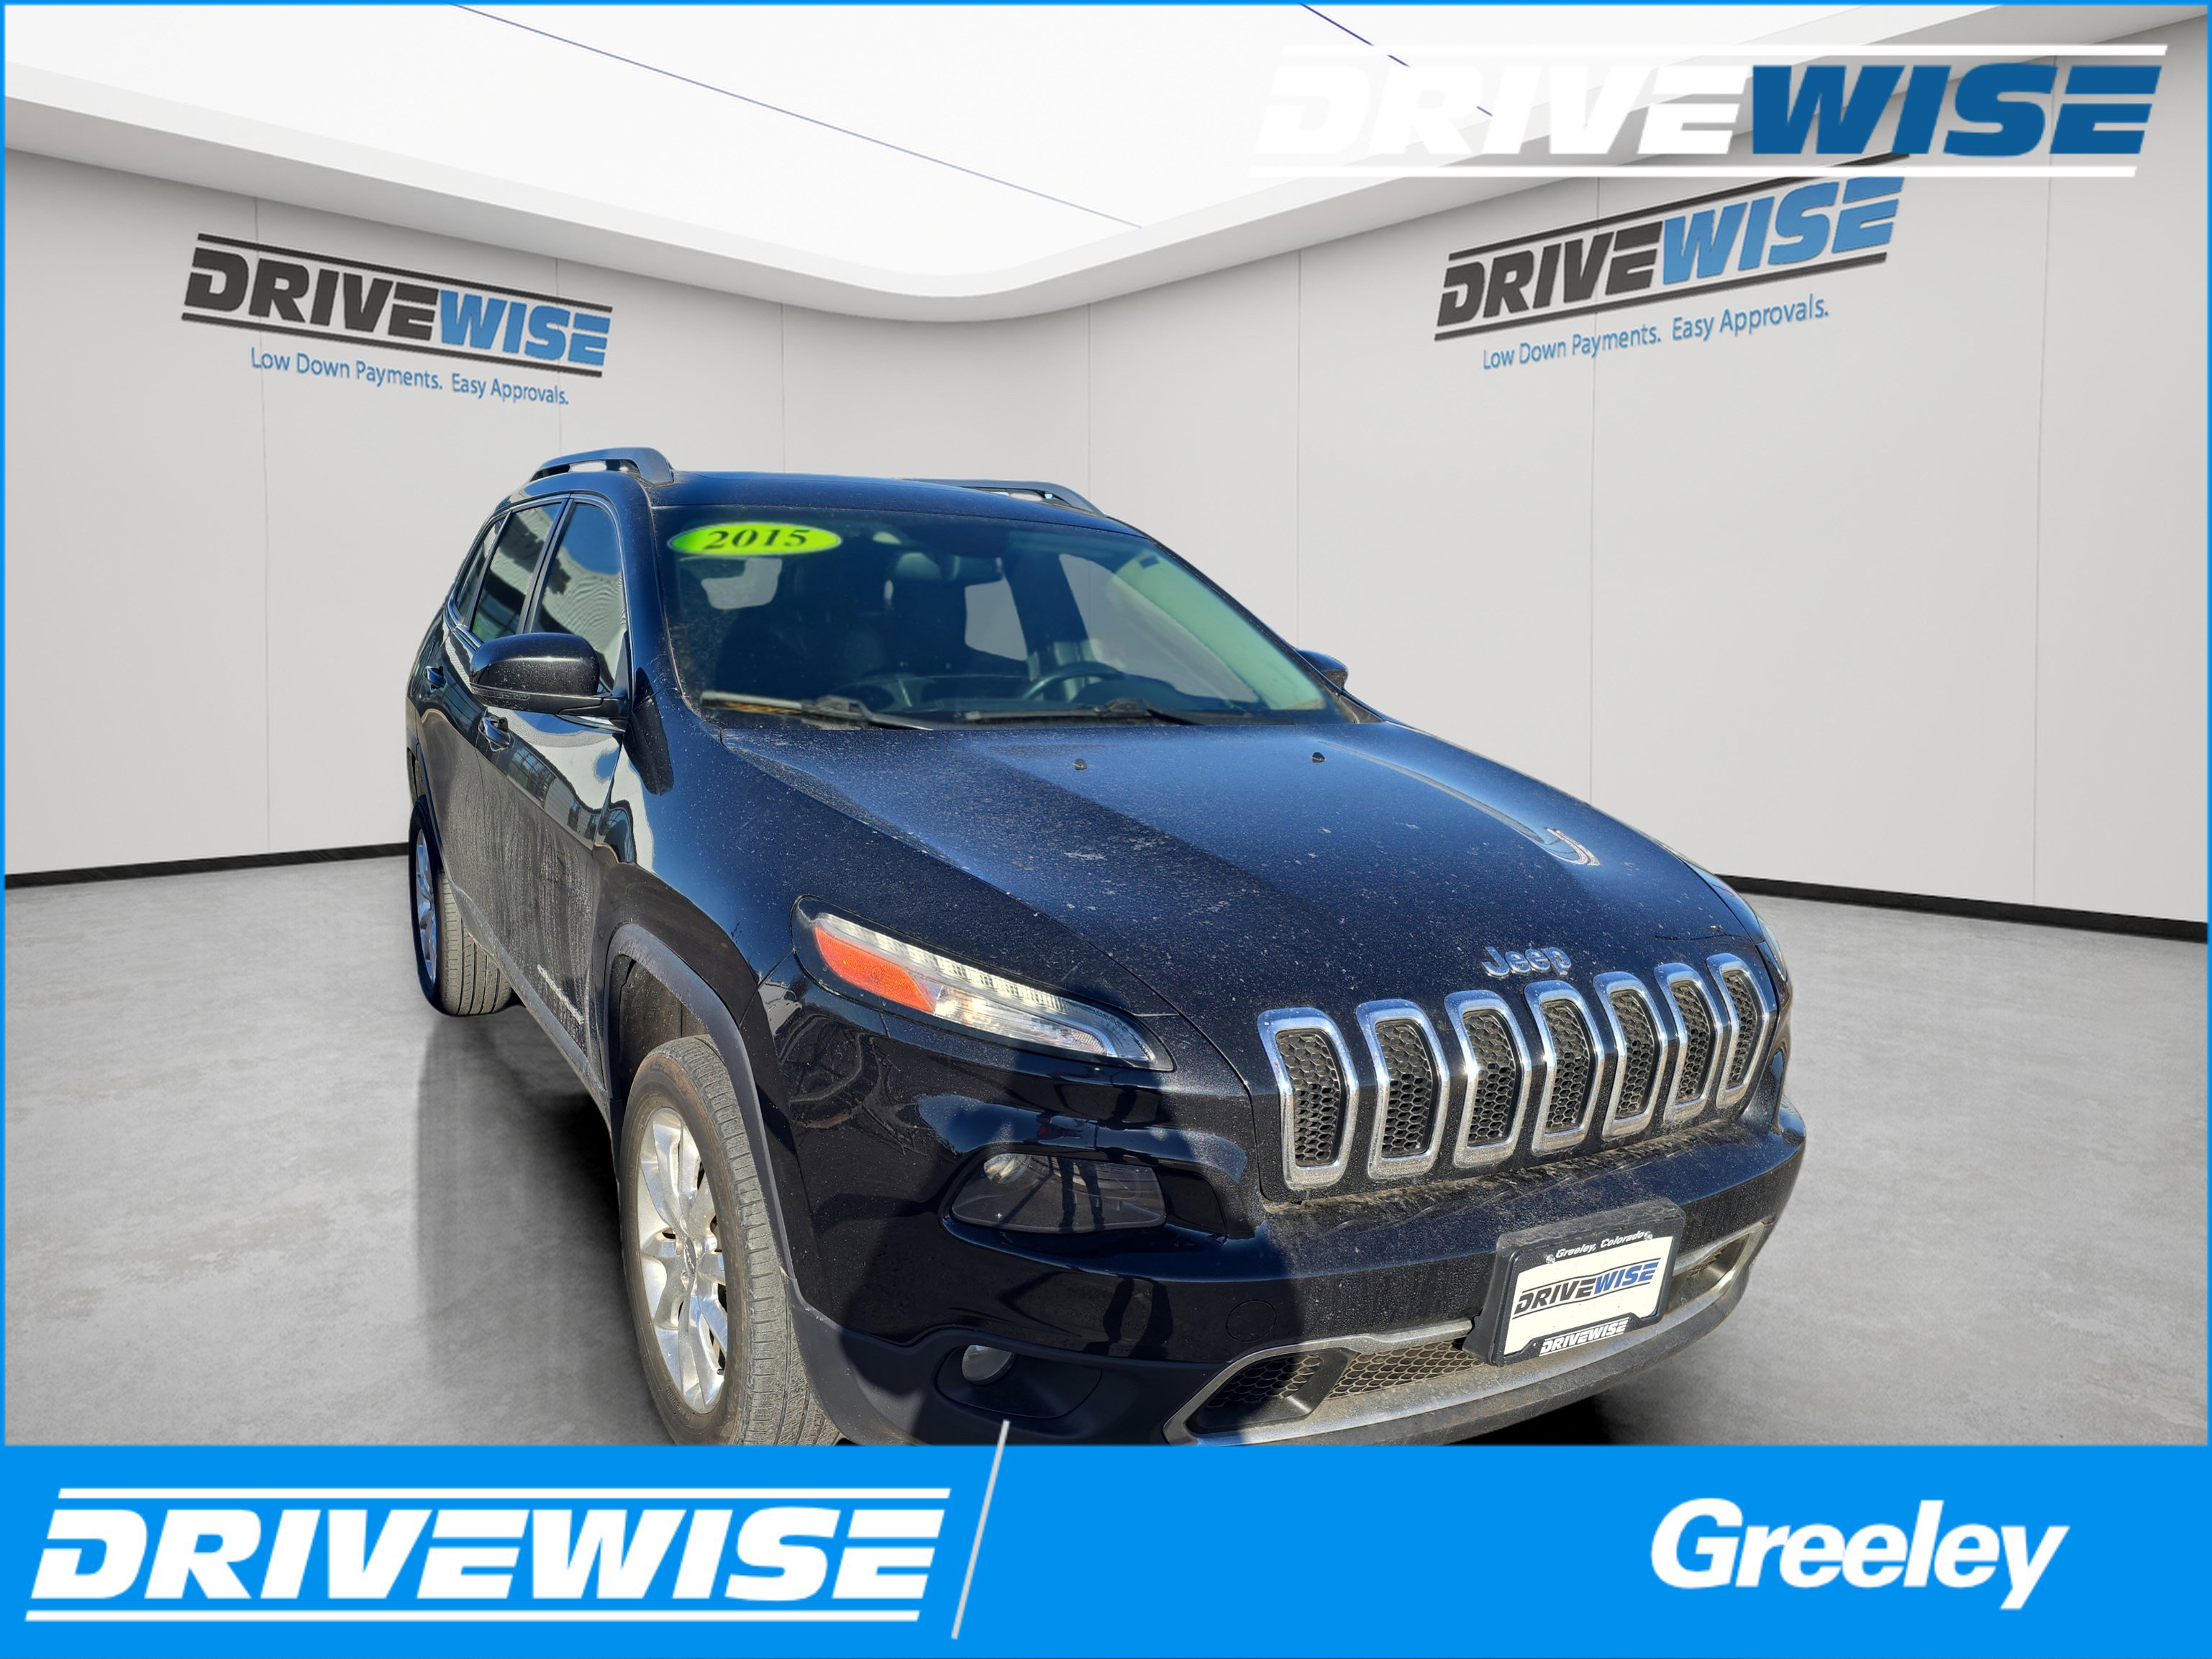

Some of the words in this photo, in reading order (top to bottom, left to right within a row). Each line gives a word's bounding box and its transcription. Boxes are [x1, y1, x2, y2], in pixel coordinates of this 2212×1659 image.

[1437, 176, 1904, 327] DRIVEWISE
[183, 247, 611, 367] DRIVEWISE
[1483, 348, 1515, 370] Low
[1519, 341, 1566, 364] Down
[1571, 325, 1662, 358] Payments.
[1672, 317, 1715, 341] Easy
[1719, 294, 1829, 335] Approvals.
[251, 347, 291, 371] Low
[296, 353, 350, 379] Down
[356, 360, 443, 389] Payments.
[451, 372, 487, 399] Easy
[491, 378, 569, 405] Approvals.
[702, 528, 811, 550] 2015
[1482, 945, 1572, 977] Jeep
[1555, 1243, 1597, 1259] Greeley,
[1600, 1230, 1645, 1248] Colorado
[1514, 1261, 1660, 1316] DRIVEWISE
[1540, 1319, 1629, 1354] DRIVEWISE
